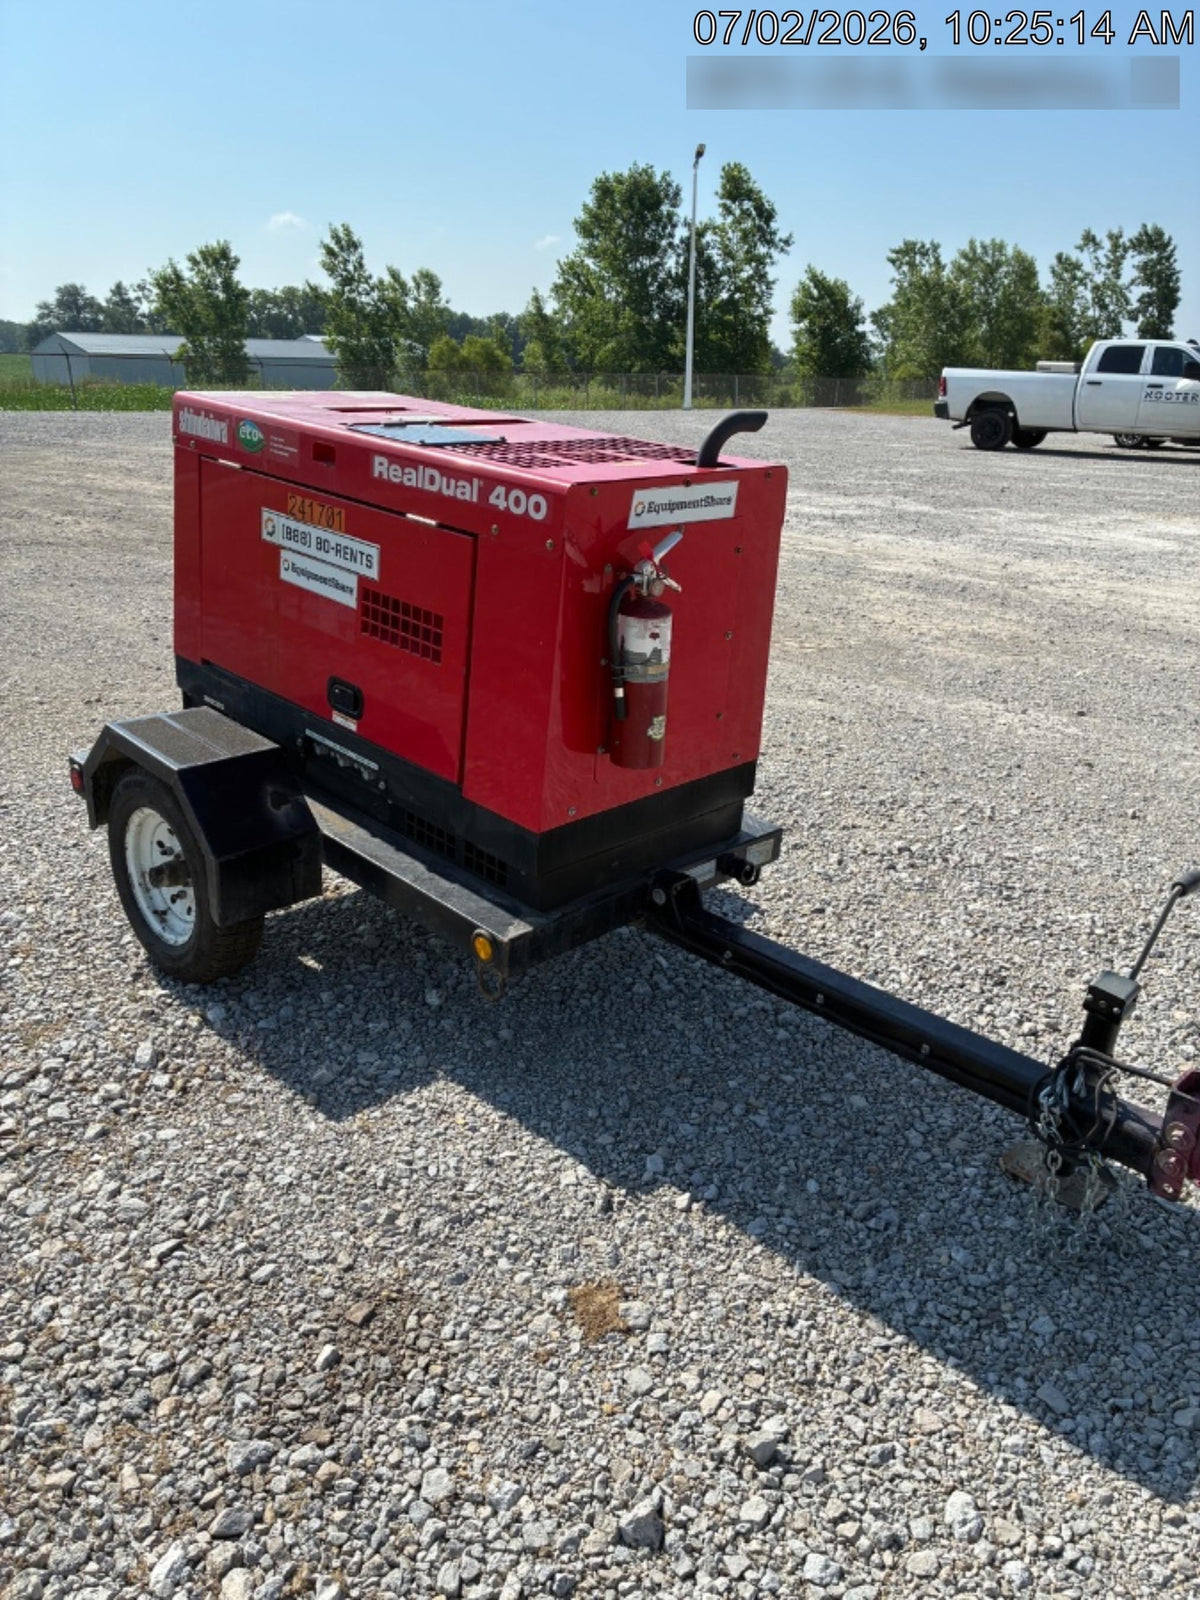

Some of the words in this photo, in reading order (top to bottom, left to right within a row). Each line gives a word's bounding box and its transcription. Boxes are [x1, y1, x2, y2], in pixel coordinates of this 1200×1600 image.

[239, 424, 259, 441] eco
[373, 455, 478, 503] RealDual
[488, 485, 548, 521] 400
[647, 495, 732, 515] EquipmentShare
[288, 495, 343, 531] 241701
[315, 535, 374, 570] 80-RENTS
[290, 561, 354, 596] EquipmentShare
